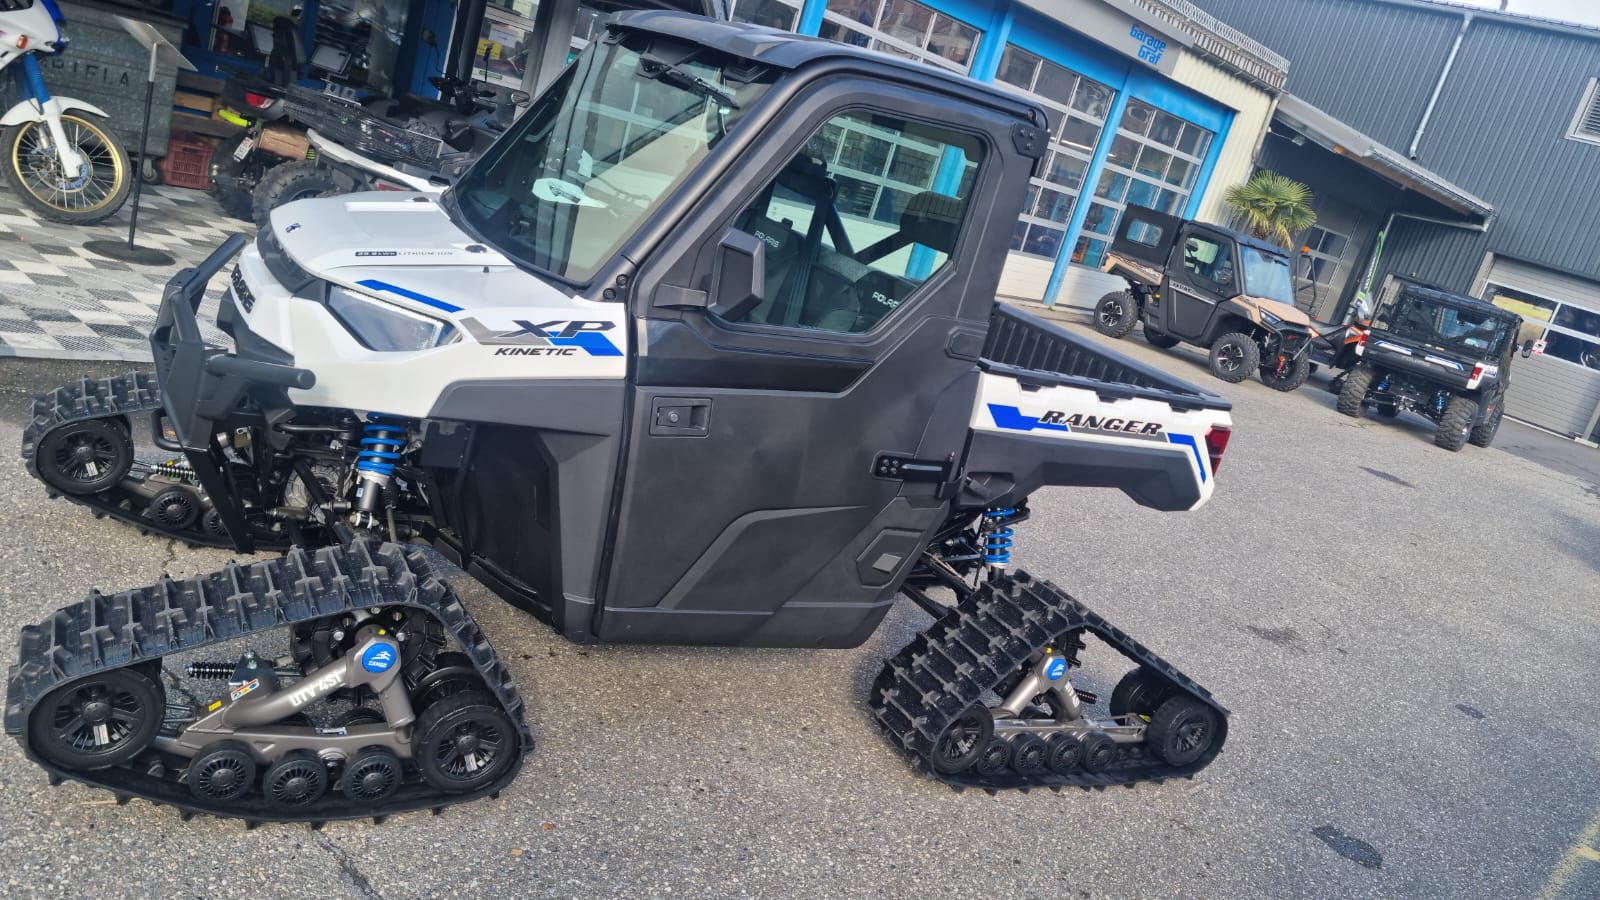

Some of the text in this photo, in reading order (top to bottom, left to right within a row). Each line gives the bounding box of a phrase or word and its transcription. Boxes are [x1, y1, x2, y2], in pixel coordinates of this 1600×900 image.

[1130, 23, 1167, 52] Garage
[1138, 44, 1162, 65] Graf
[872, 291, 900, 309] POLAR
[497, 319, 616, 338] XP
[494, 347, 577, 356] KINETIC
[1039, 410, 1163, 435] RANGER
[289, 685, 317, 707] UTV
